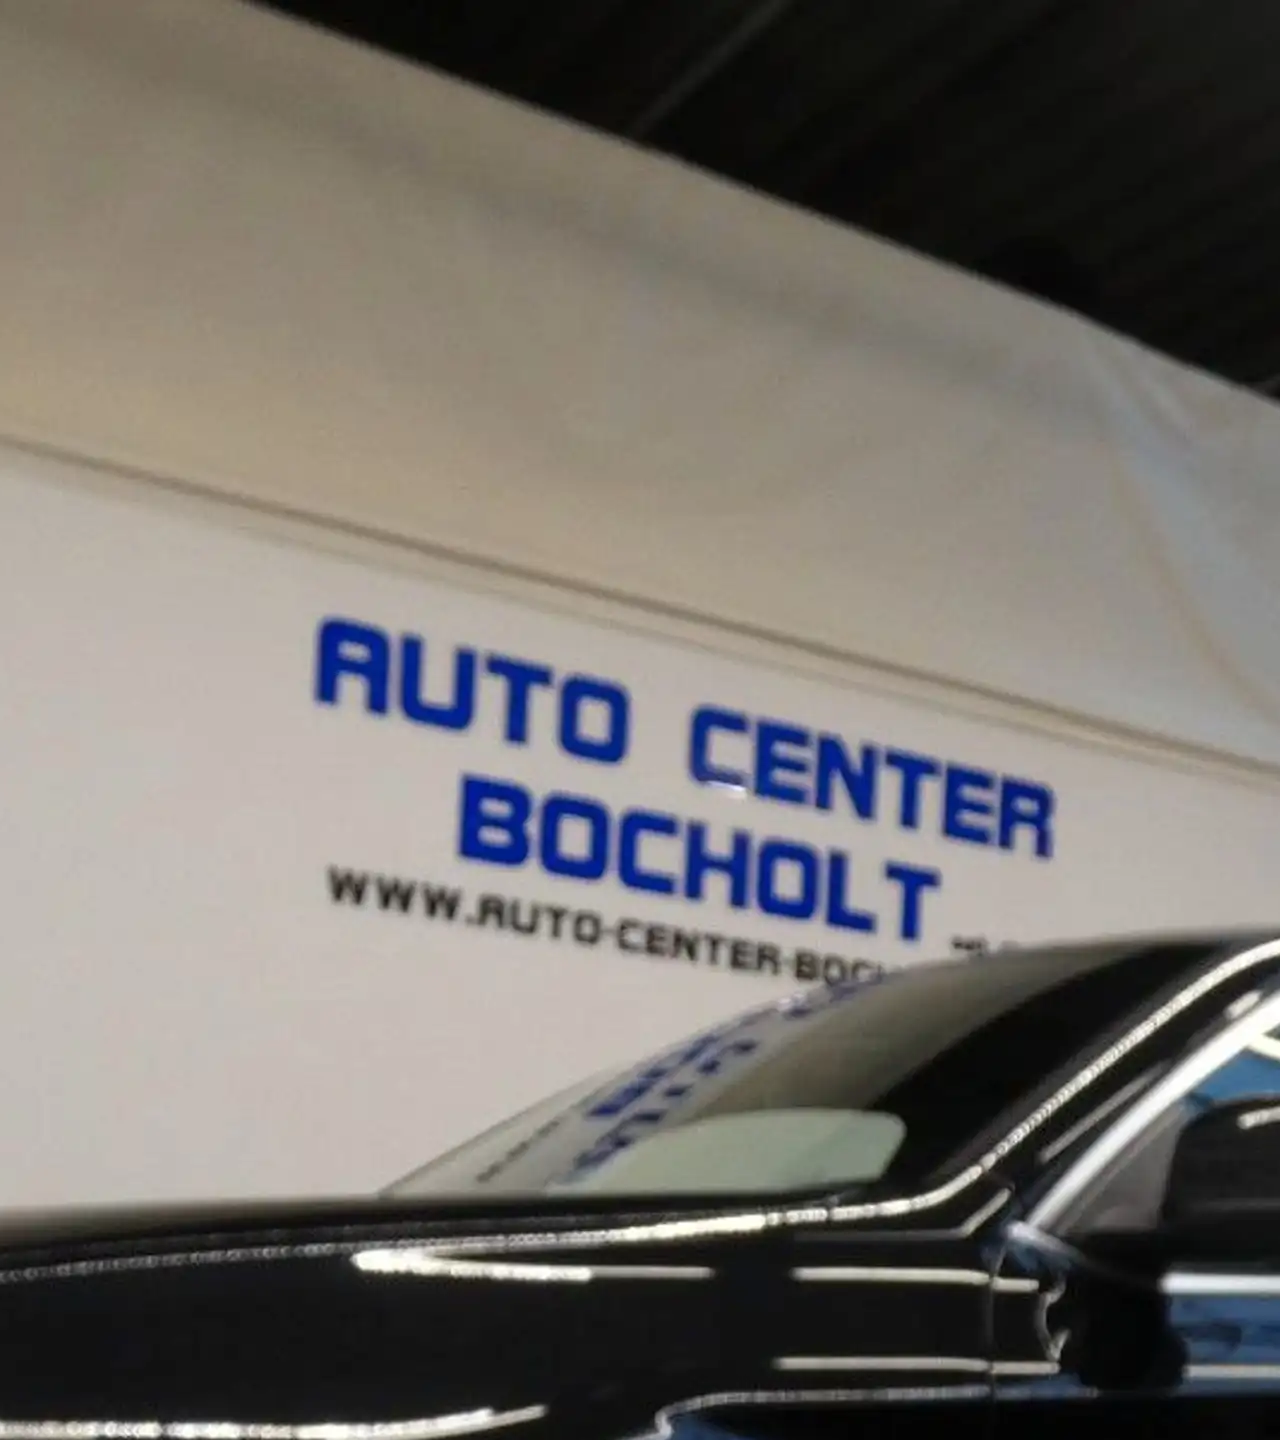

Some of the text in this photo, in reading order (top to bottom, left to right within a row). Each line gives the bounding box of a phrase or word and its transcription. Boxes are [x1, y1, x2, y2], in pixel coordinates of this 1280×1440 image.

[314, 617, 1057, 858] AUTO CENTER
[457, 773, 941, 943] BOCHOLT
